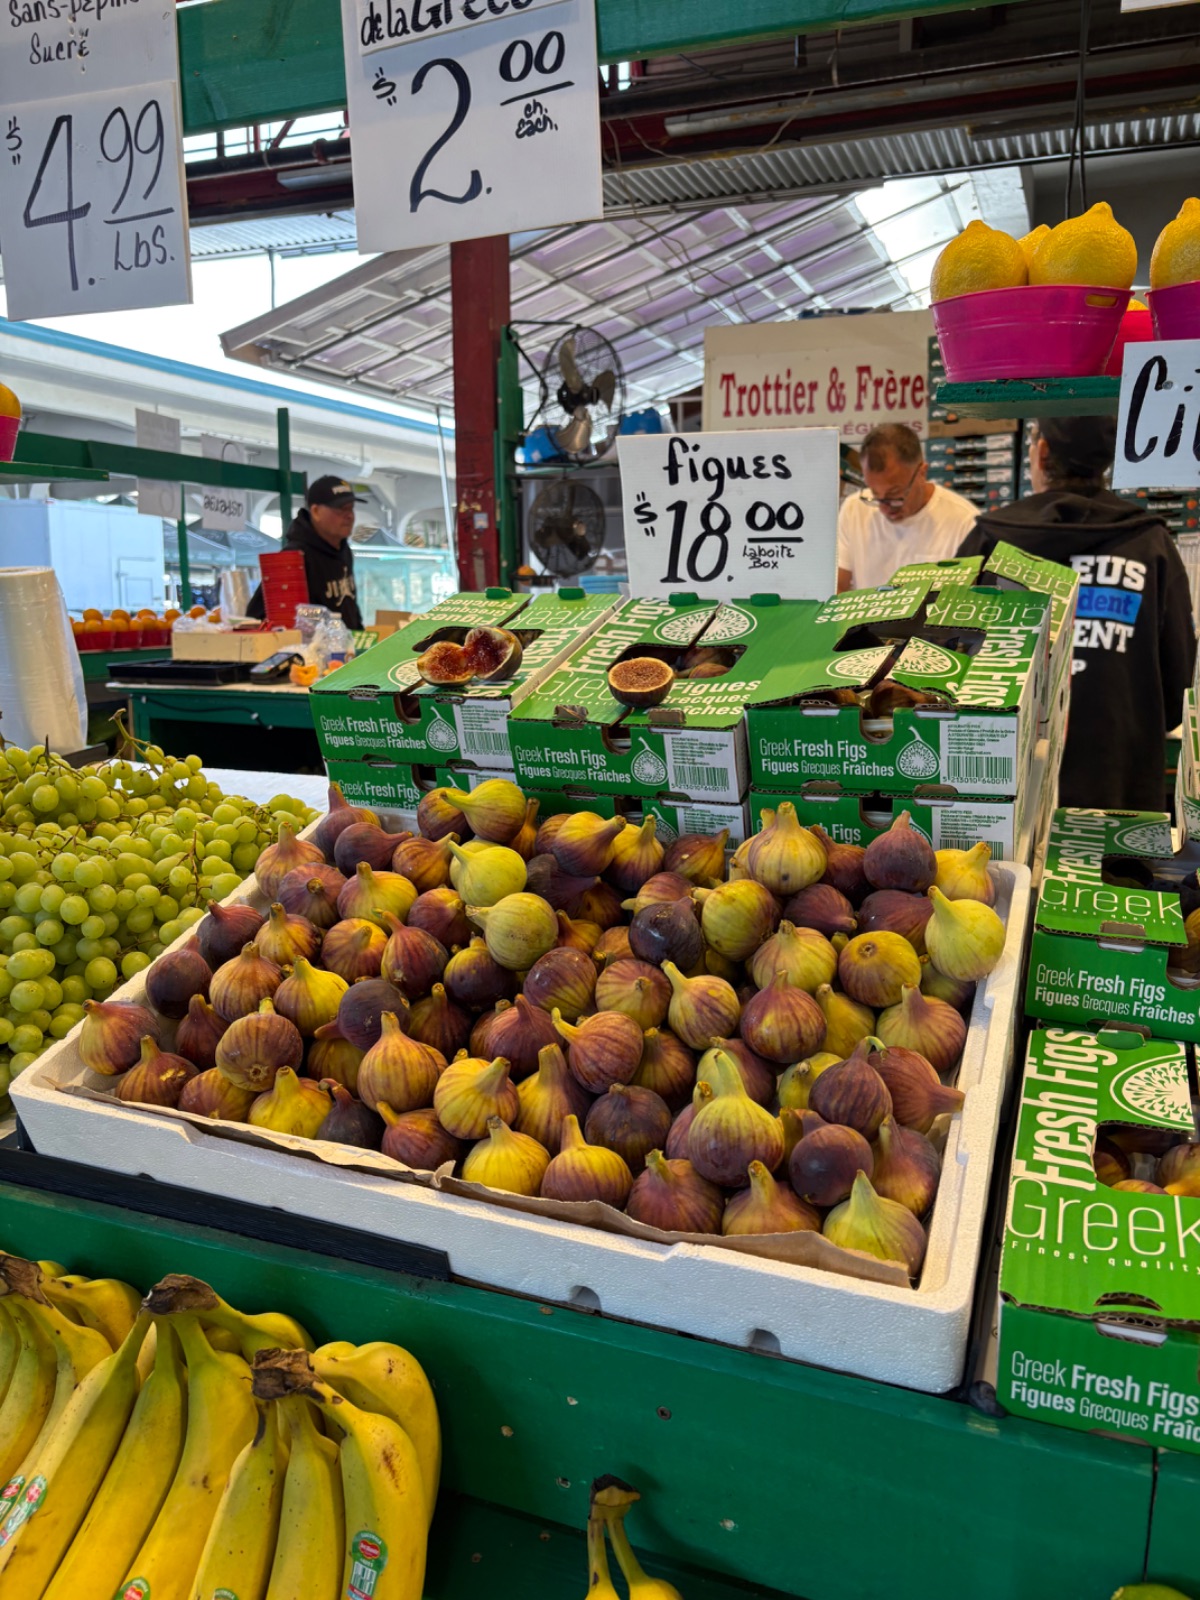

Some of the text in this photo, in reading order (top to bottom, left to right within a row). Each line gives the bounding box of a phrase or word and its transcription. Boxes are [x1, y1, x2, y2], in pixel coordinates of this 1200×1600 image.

[719, 365, 928, 417] Trottier & Frère
[1124, 355, 1200, 463] Ci
[663, 437, 792, 501] figues
[748, 558, 779, 569] Box
[1069, 555, 1147, 591] EUS
[823, 596, 915, 614] Grecques
[829, 586, 921, 605] Fraîches
[814, 605, 910, 624] Figues
[559, 630, 644, 675] Fresh
[971, 626, 1043, 667] Fresh
[536, 671, 613, 700] Gre
[667, 681, 762, 696] Figues
[320, 716, 404, 738] Greek Fresh Figs
[325, 733, 427, 750] Figues Grecques Fraîches
[515, 745, 607, 769] Greek Fresh Figs
[759, 738, 867, 762] Greek Fresh Figs
[519, 764, 631, 783] Figues Grecques Fraîches
[762, 759, 895, 777] Figues Grecques Fraîches
[364, 782, 396, 797] Fresh
[397, 784, 420, 802] Figs
[832, 824, 861, 843] Figs
[1042, 808, 1120, 886] Fresh Figs
[1040, 877, 1183, 919] Greek
[1036, 963, 1166, 1002] Greek Fresh Figs
[1035, 986, 1195, 1025] Figues Grecques Fraîches
[1012, 1027, 1118, 1191] Fresh Figs
[1006, 1178, 1200, 1258] Greek
[1012, 1240, 1089, 1264] Finest
[1011, 1350, 1200, 1419] Greek Fresh Figs
[1010, 1380, 1076, 1413] Figues
[1079, 1397, 1149, 1431] Grecques
